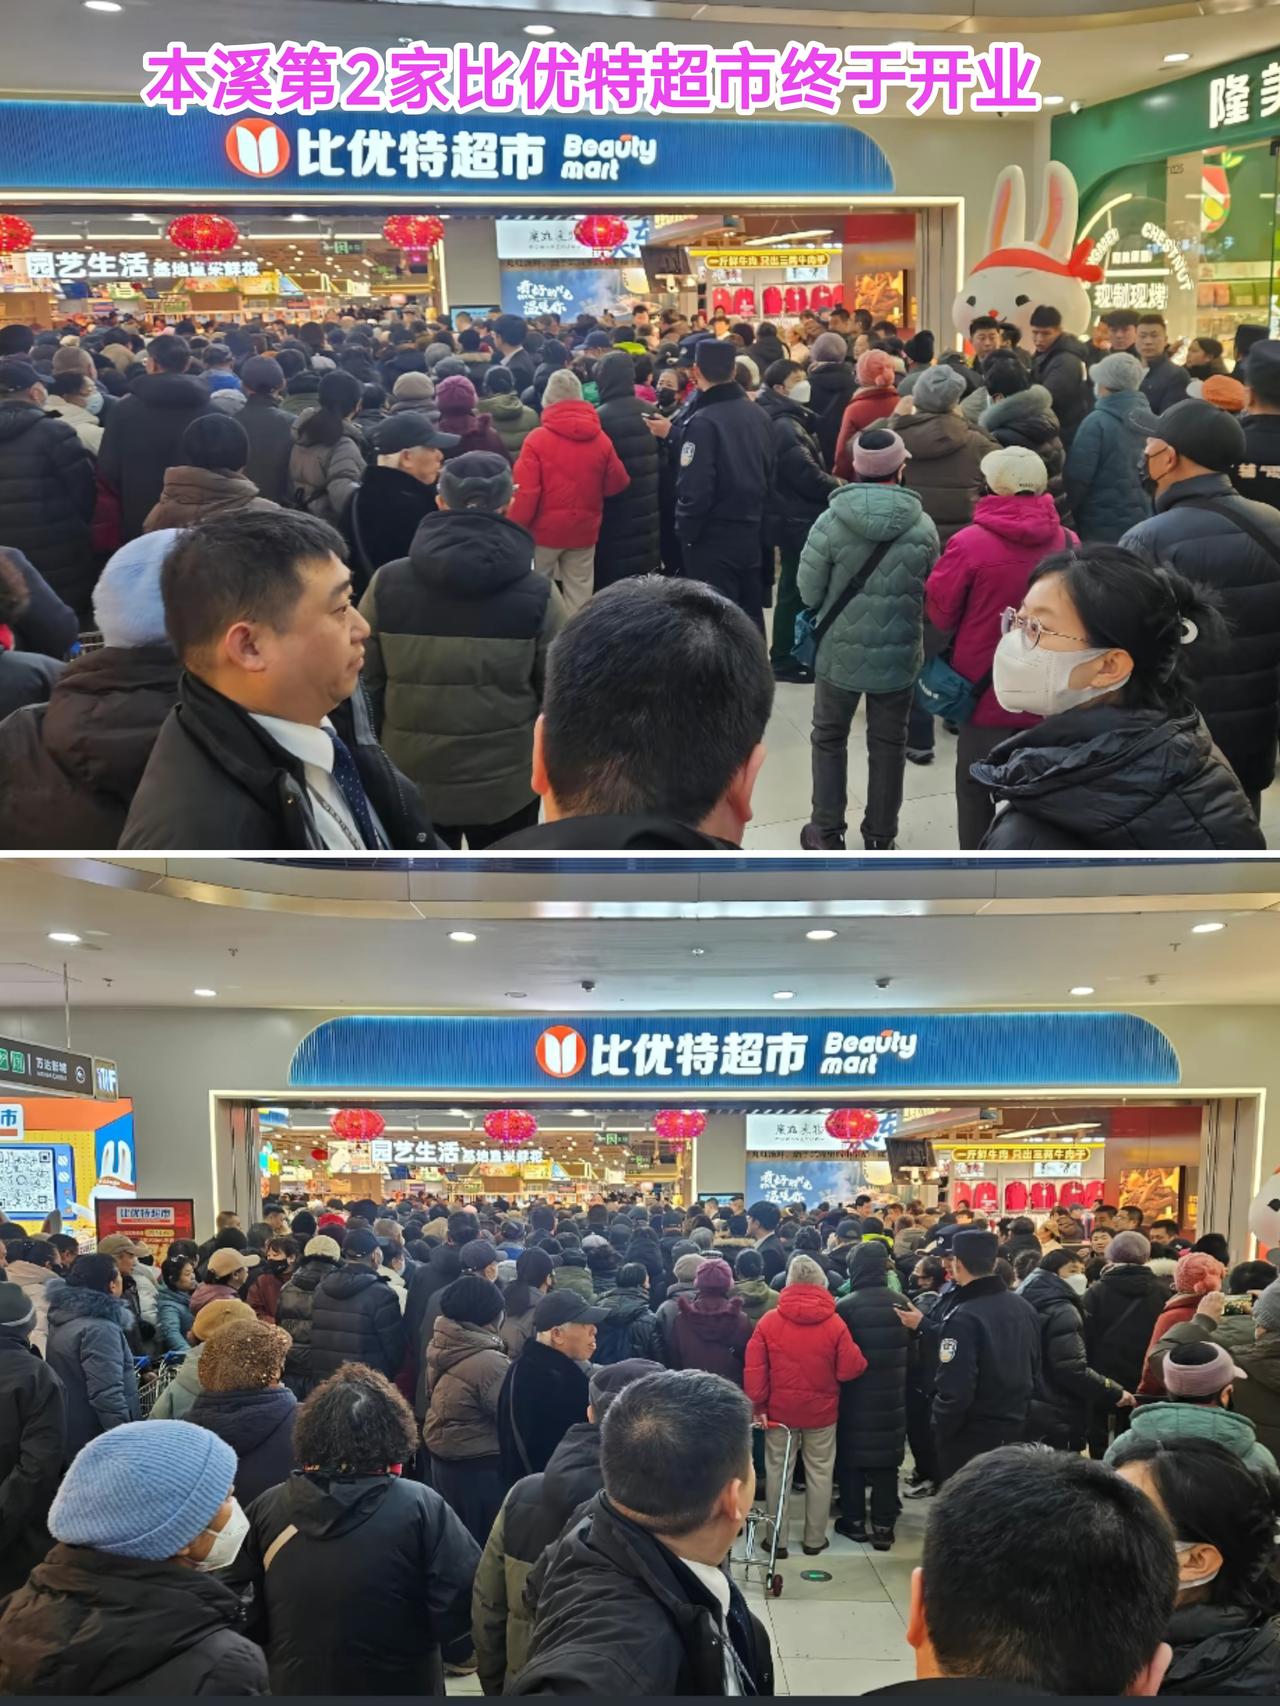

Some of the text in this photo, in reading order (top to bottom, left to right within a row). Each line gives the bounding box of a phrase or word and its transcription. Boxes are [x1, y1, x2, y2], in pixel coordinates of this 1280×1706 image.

[297, 128, 545, 180] 比优特超市
[562, 134, 656, 165] Beauty
[560, 158, 619, 180] mart
[26, 251, 149, 278] 园艺生活
[1141, 221, 1194, 291] CHESTNUT
[1094, 283, 1168, 310] 现制现烤
[591, 1032, 808, 1076] 比优特超市
[824, 1028, 917, 1059] Beauty
[820, 1054, 877, 1074] mart
[371, 1139, 460, 1163] 园艺生活
